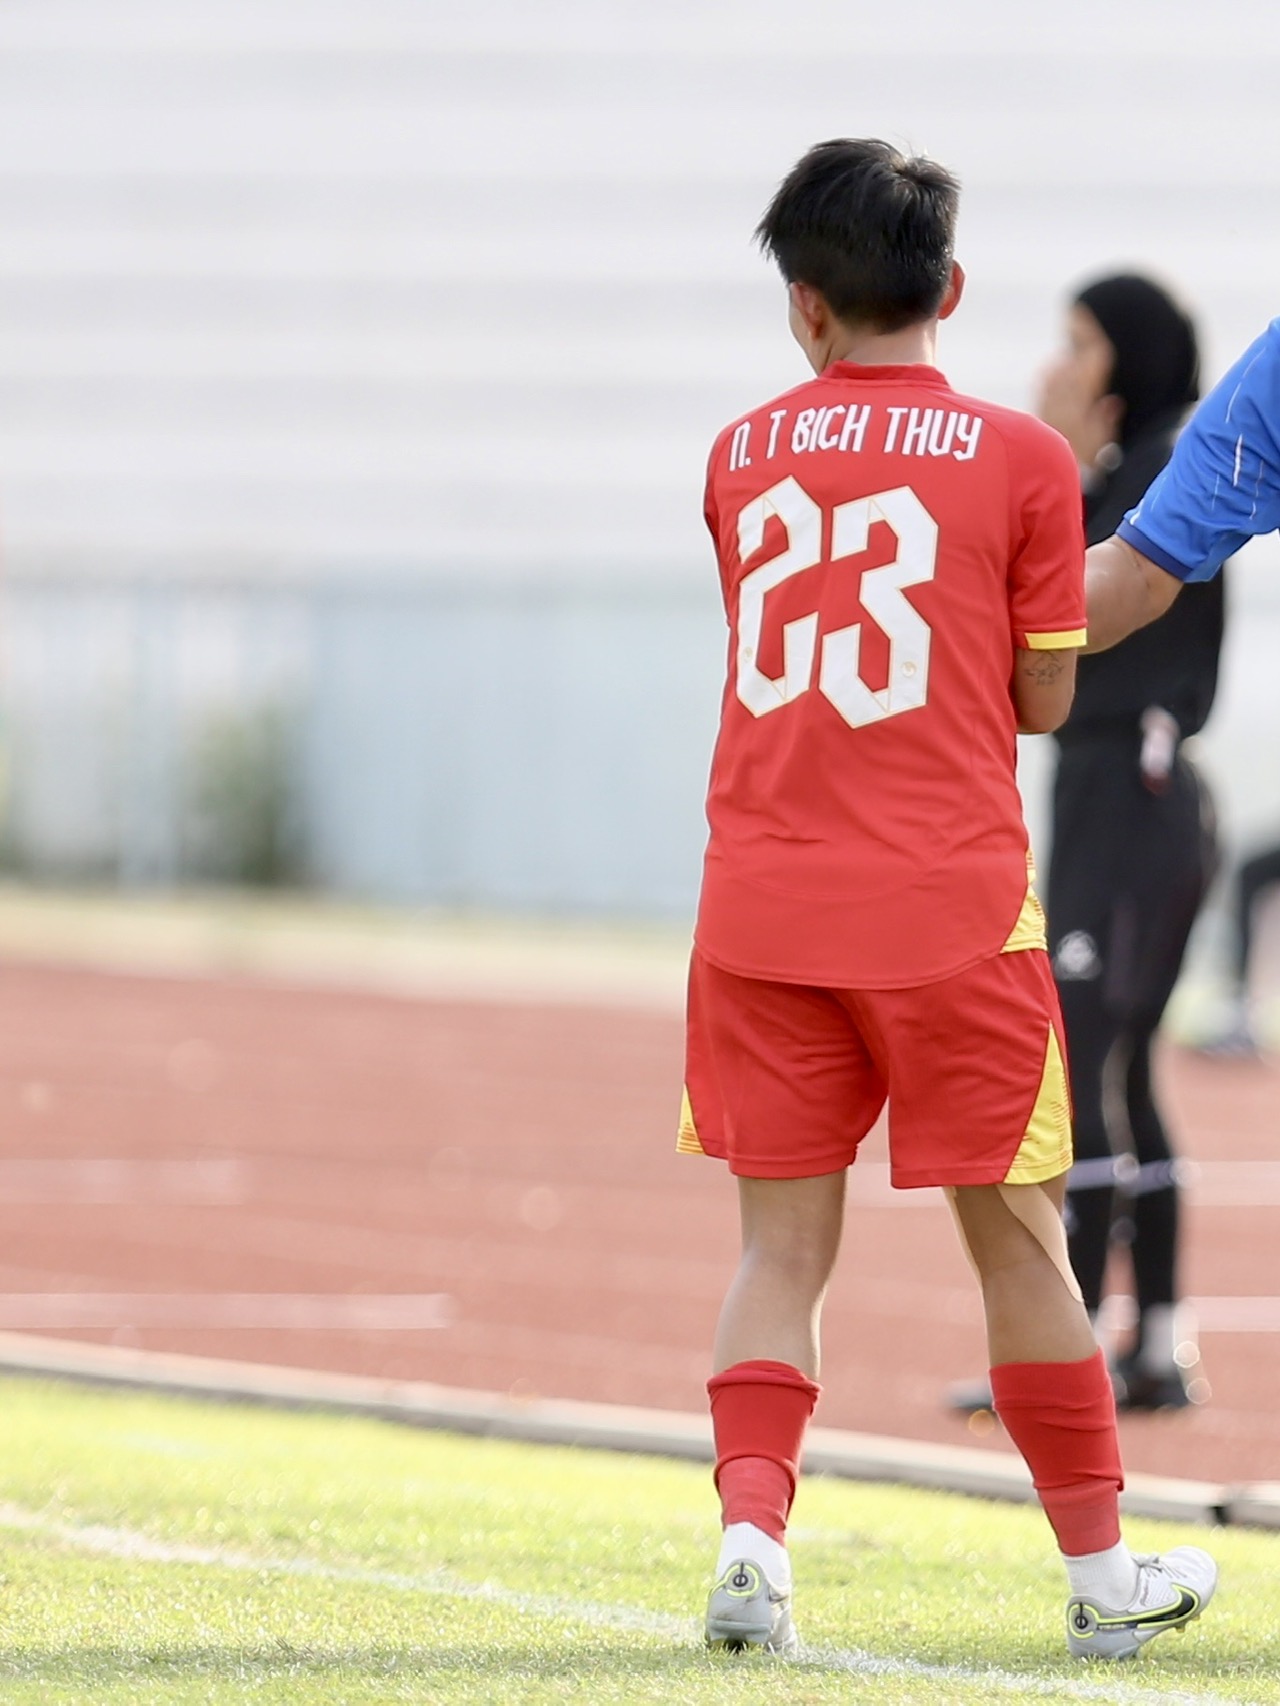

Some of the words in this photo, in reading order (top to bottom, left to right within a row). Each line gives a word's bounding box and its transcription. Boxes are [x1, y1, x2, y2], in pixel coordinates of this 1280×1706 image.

[766, 409, 788, 460] T
[791, 404, 872, 455] BICH
[883, 406, 983, 462] THUY
[736, 474, 940, 730] 23
